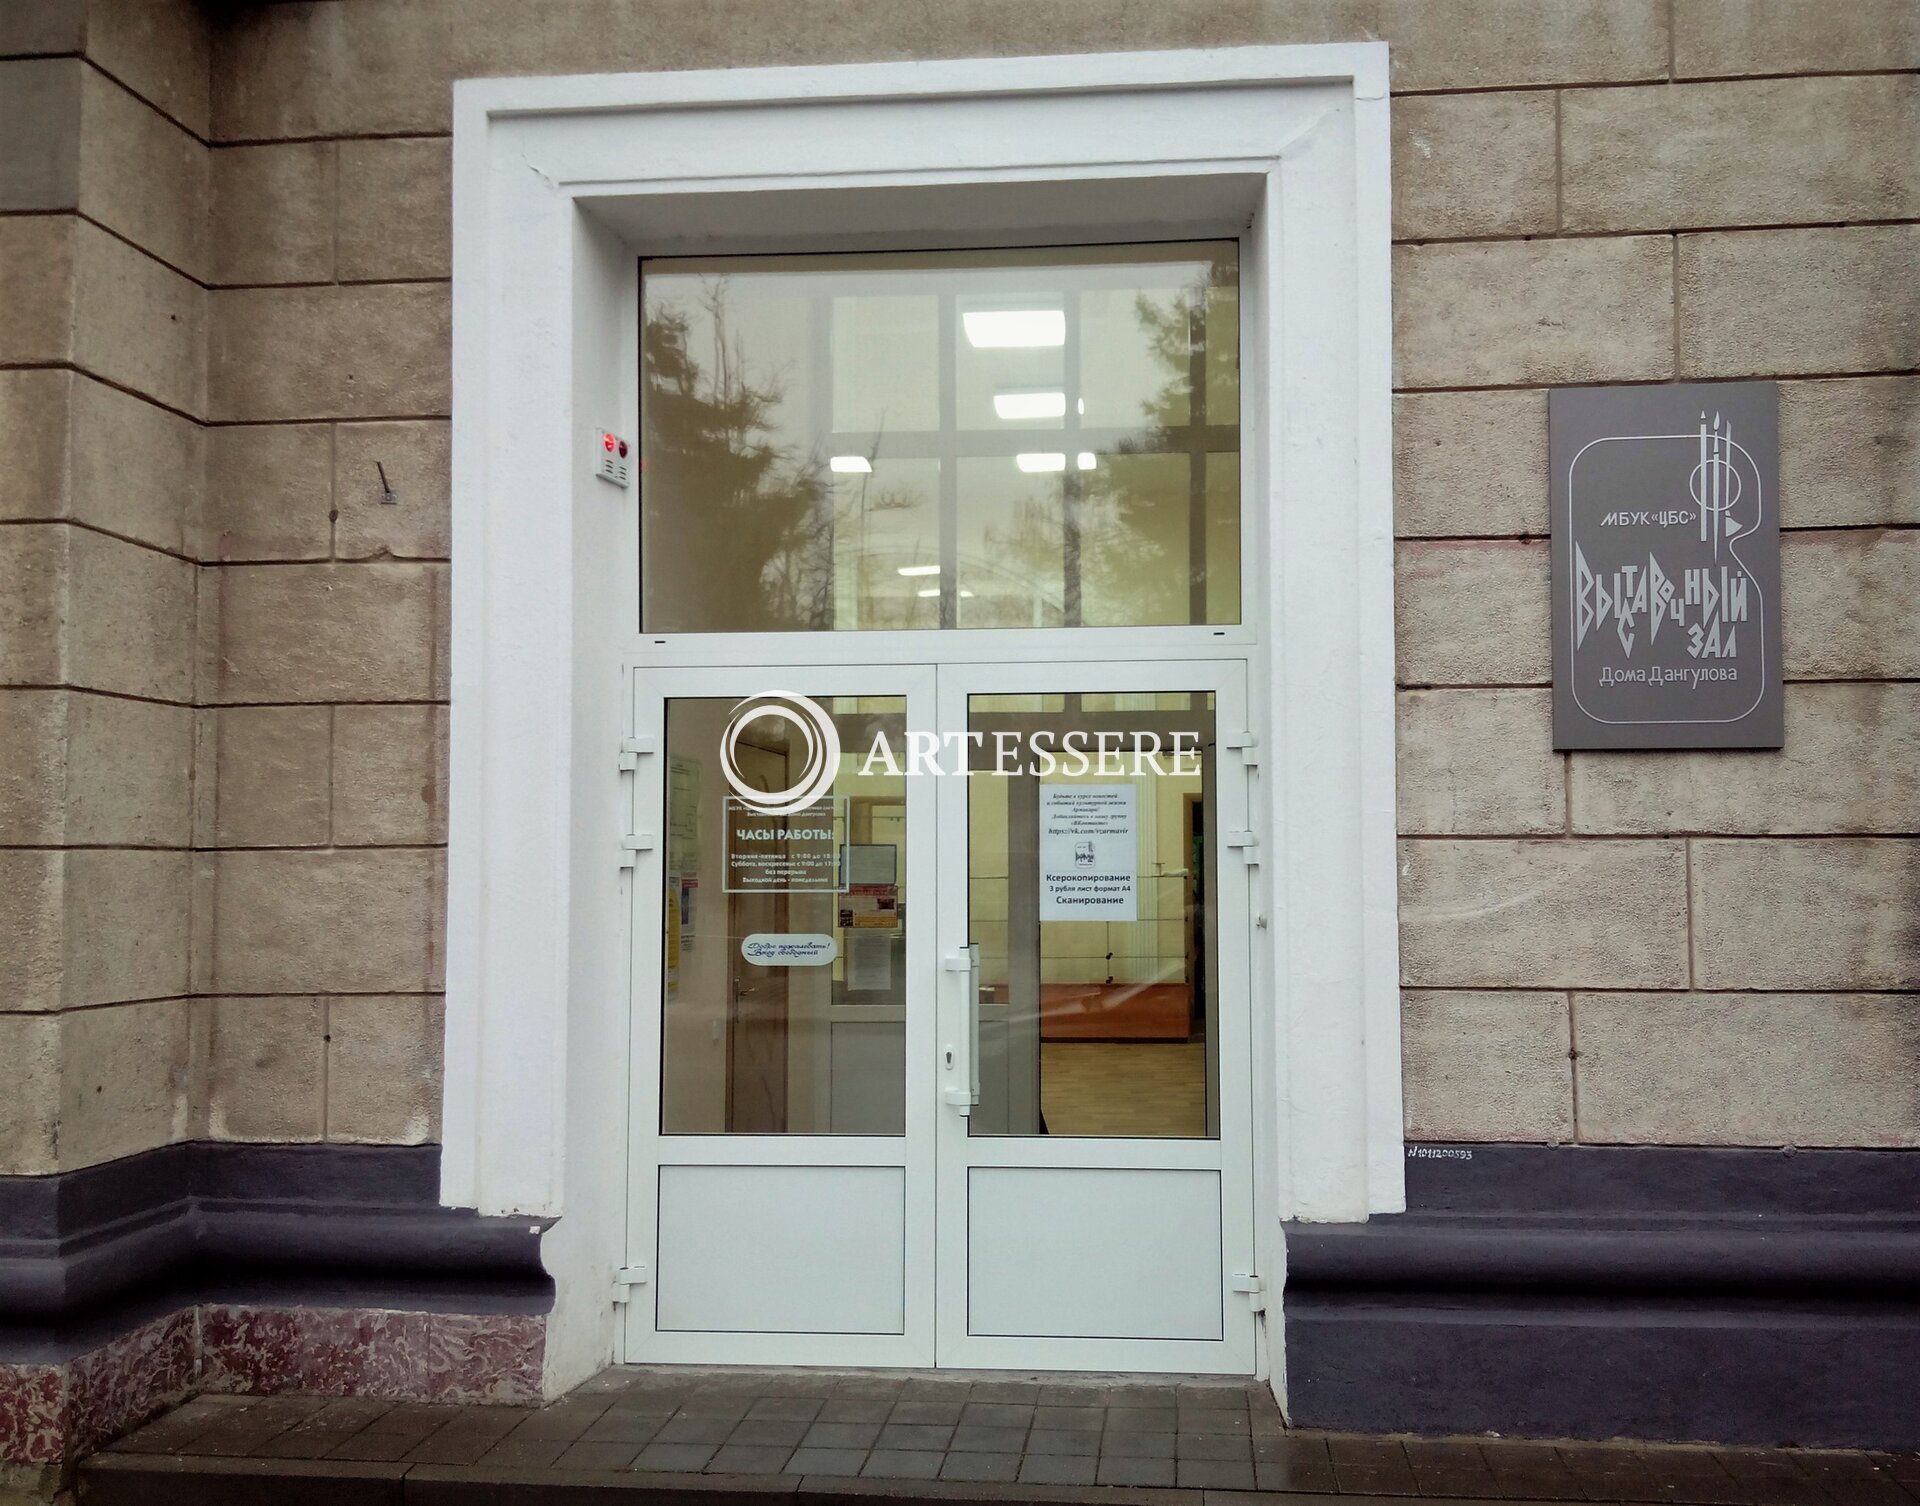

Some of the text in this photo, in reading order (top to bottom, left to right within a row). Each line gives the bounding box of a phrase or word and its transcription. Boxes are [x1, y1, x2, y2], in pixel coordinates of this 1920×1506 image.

[1599, 666, 1738, 689] Дома Дангулова
[736, 829, 774, 840] ЧАСЫ
[1046, 874, 1131, 883] Ксерокопирование
[1055, 885, 1076, 893] рубля
[1093, 885, 1120, 893] формат
[1056, 896, 1124, 905] Сканирование
